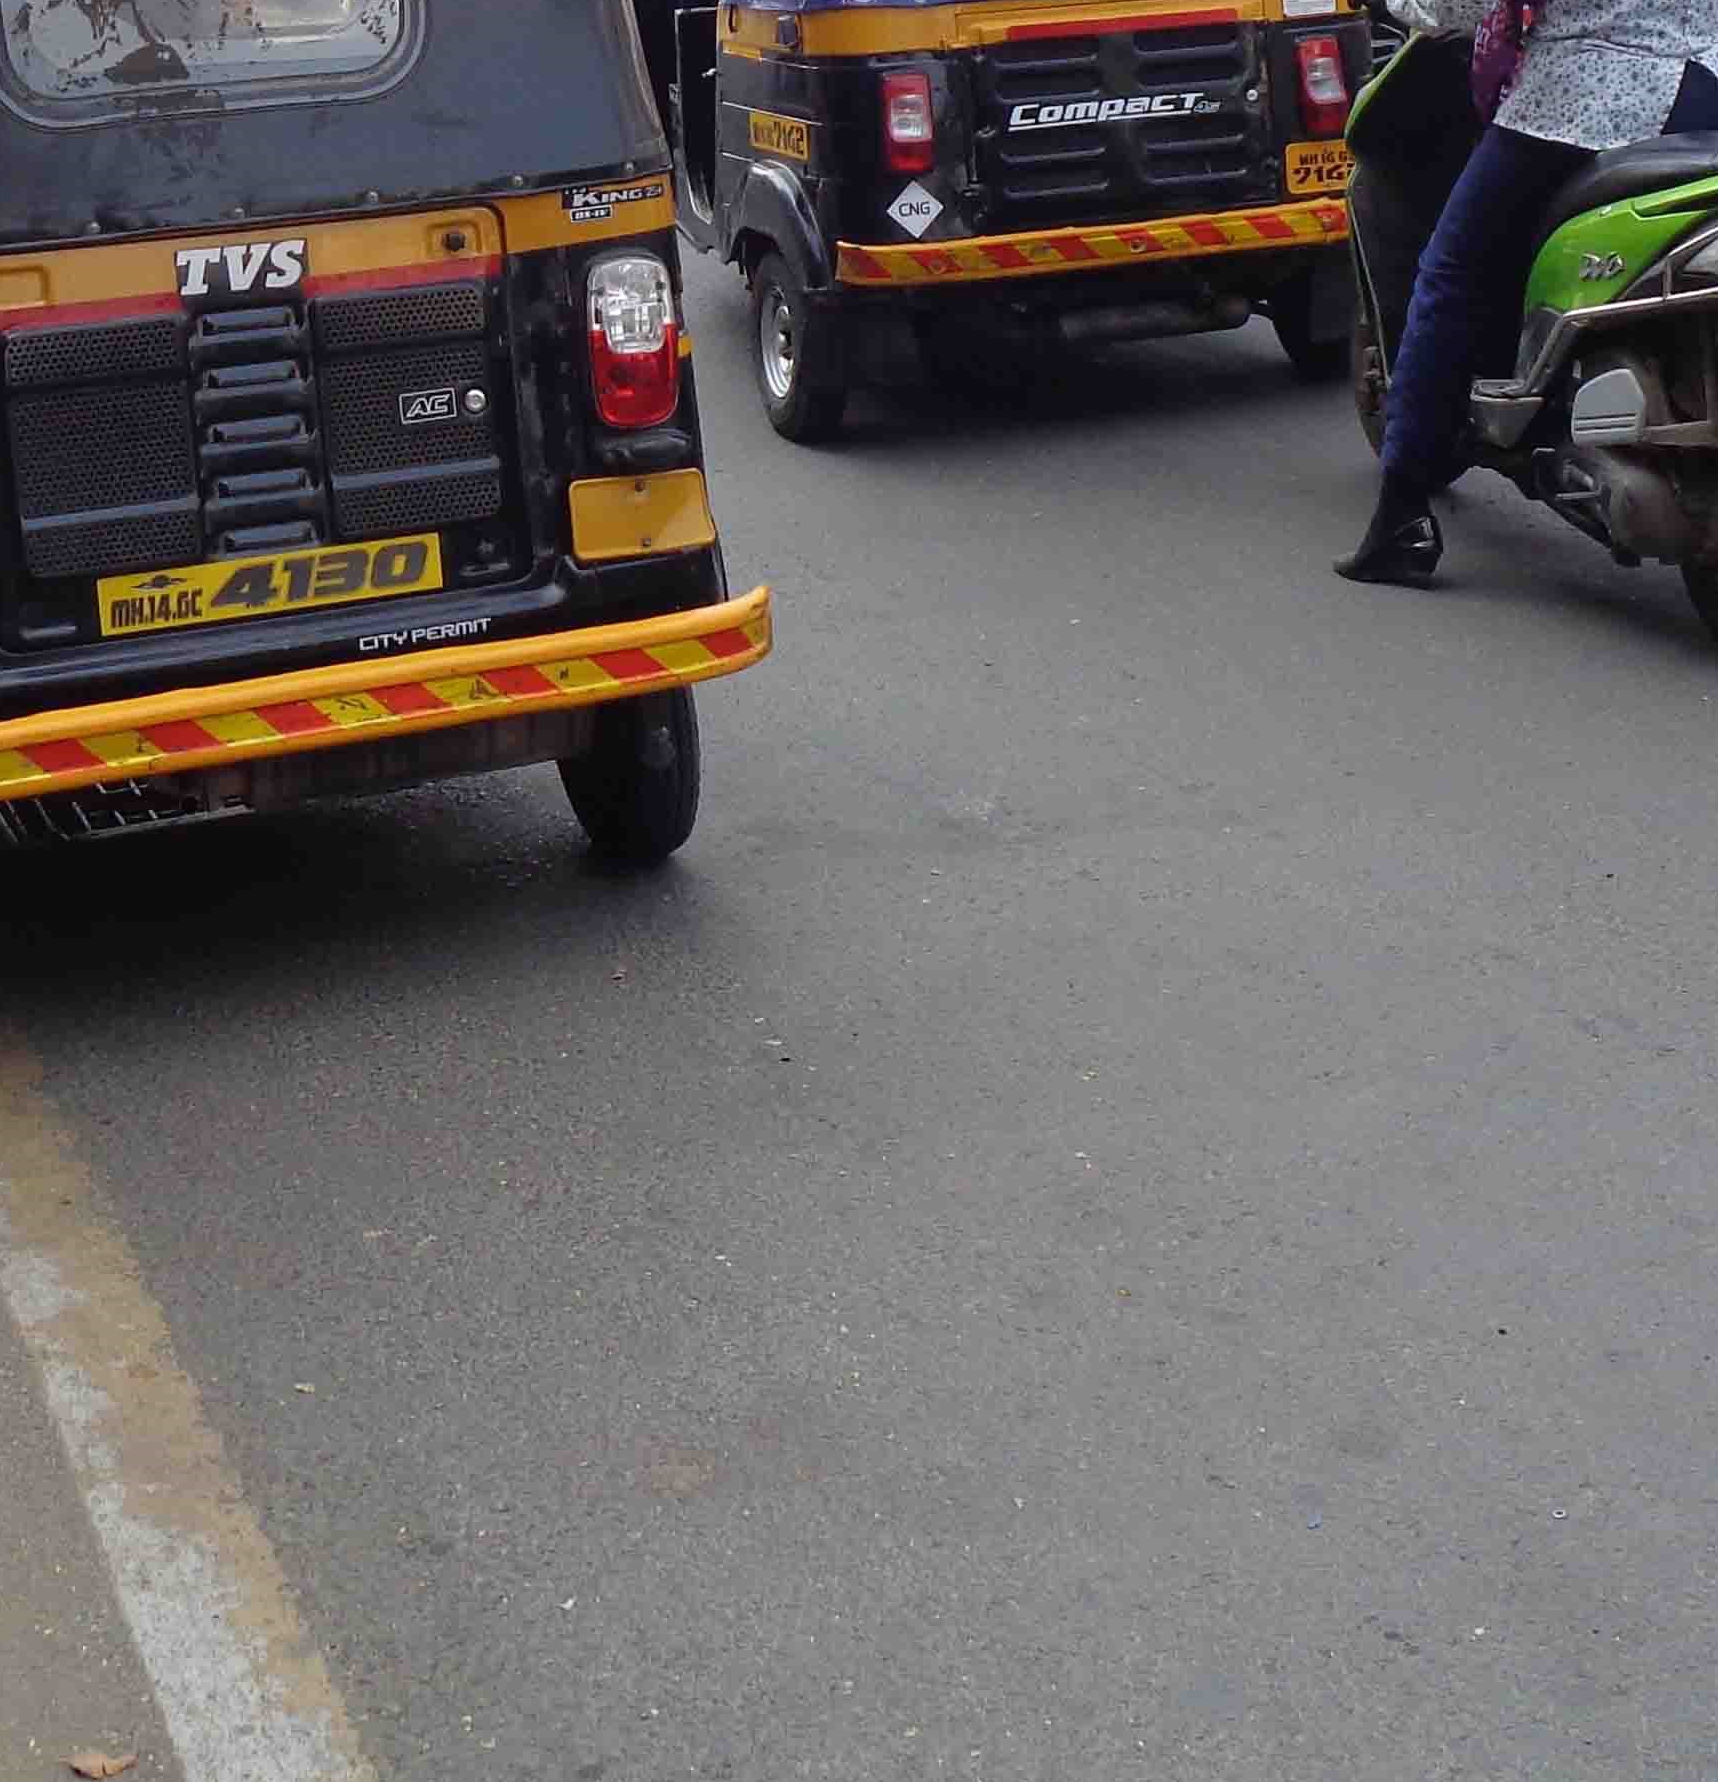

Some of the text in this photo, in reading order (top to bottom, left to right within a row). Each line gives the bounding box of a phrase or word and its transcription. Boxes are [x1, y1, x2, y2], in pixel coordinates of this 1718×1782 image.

[898, 201, 931, 218] CNG
[174, 239, 306, 296] TVS
[210, 541, 428, 609] 4130
[358, 617, 492, 653] CITY PERMIT
